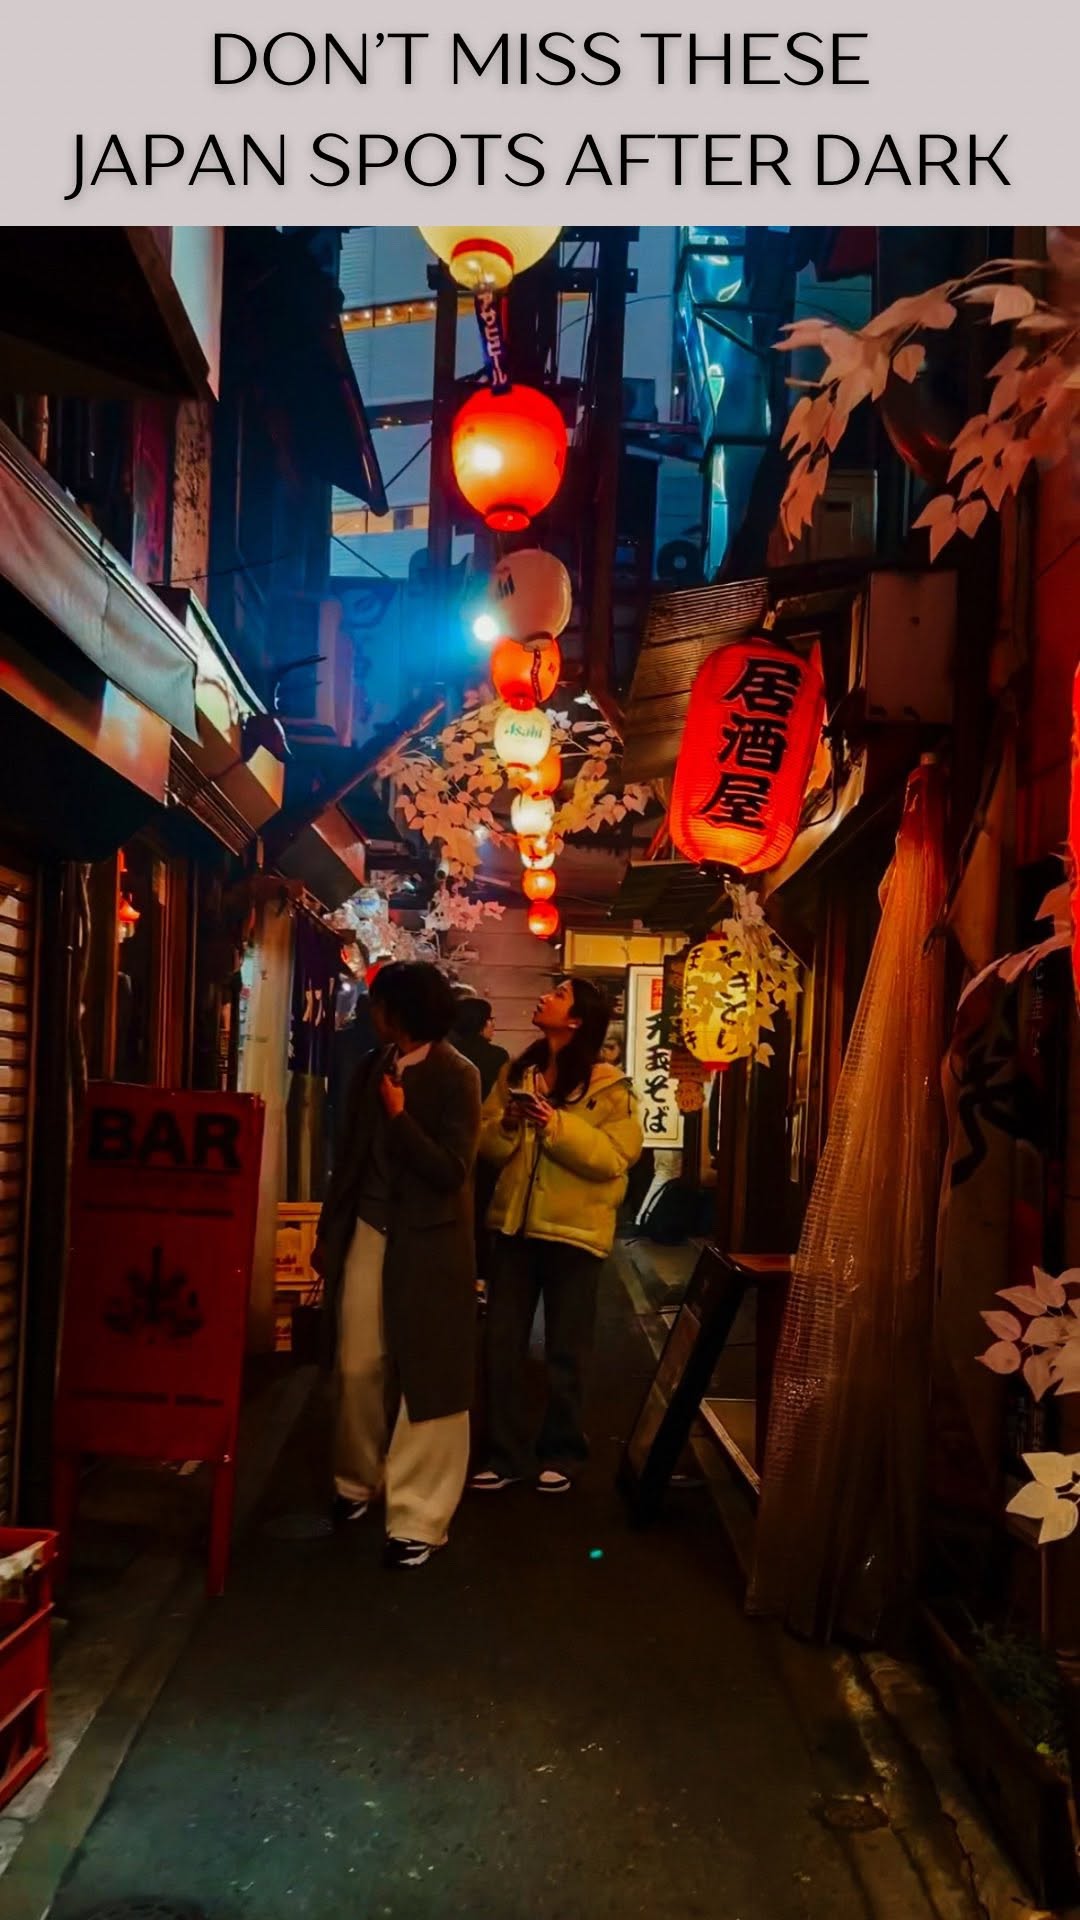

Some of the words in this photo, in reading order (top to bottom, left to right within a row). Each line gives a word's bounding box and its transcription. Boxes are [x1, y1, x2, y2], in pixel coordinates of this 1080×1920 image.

[504, 722, 543, 739] Asahi
[700, 658, 802, 830] 居酒屋
[88, 1106, 242, 1169] BAR
